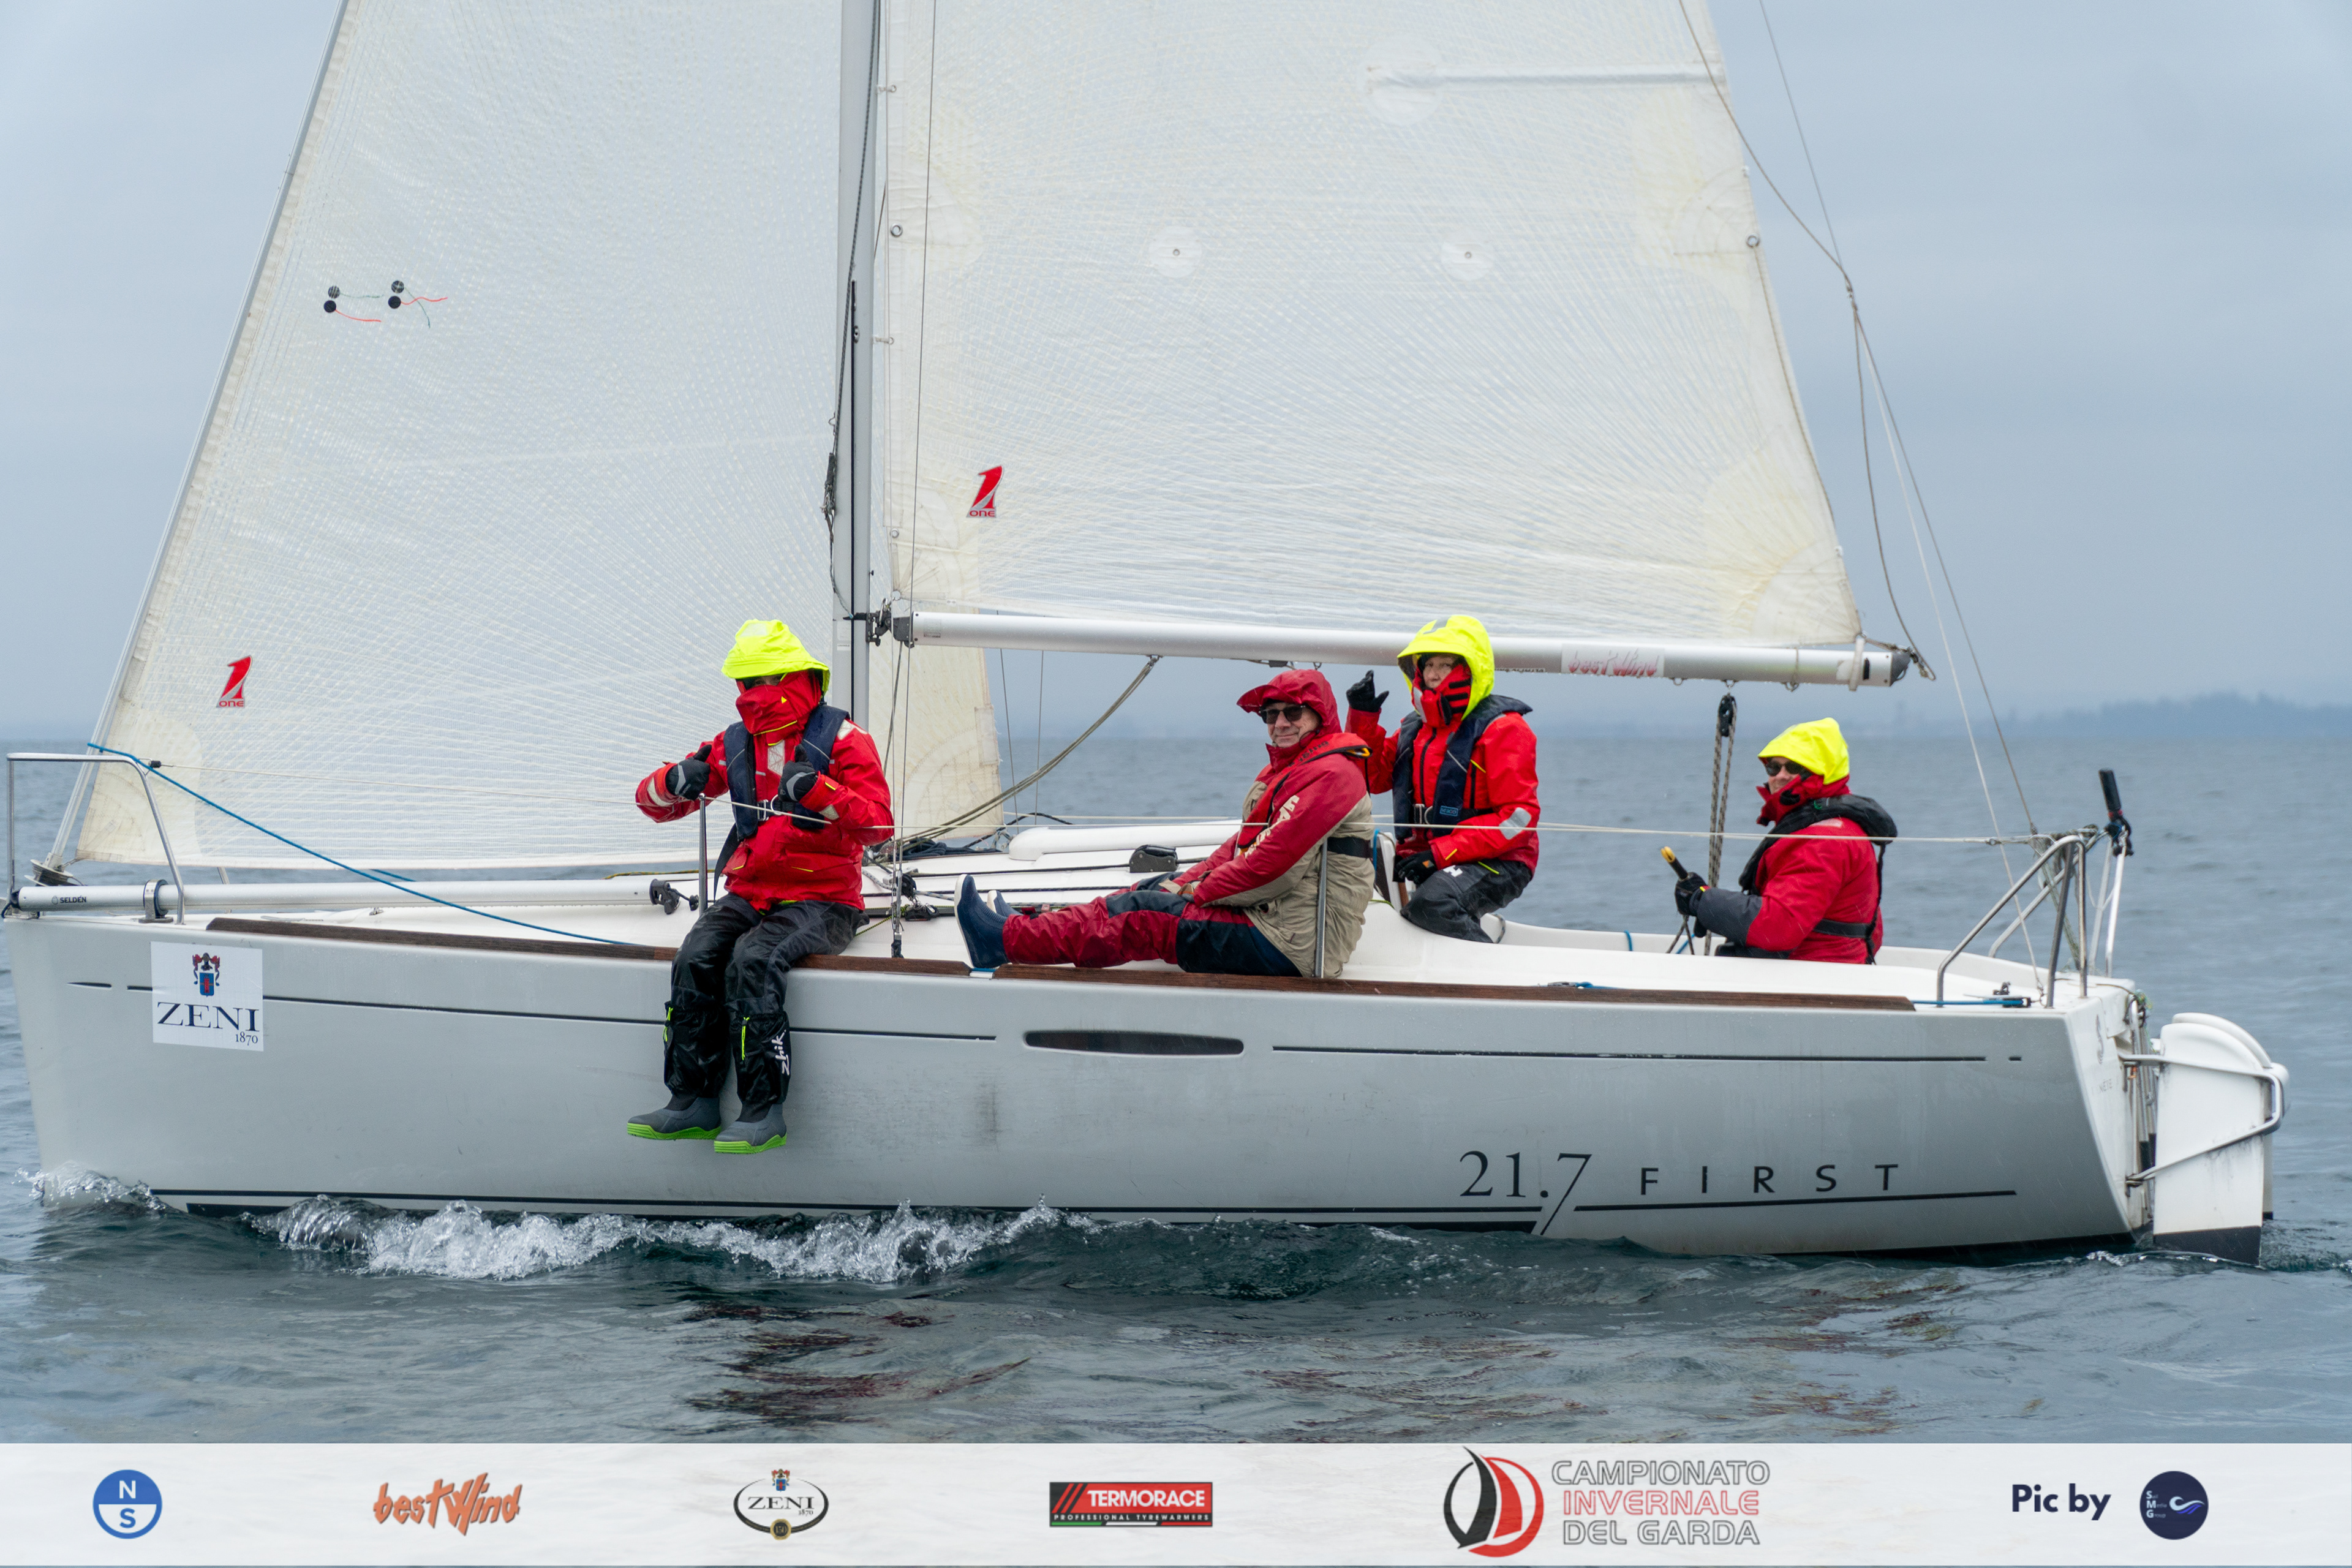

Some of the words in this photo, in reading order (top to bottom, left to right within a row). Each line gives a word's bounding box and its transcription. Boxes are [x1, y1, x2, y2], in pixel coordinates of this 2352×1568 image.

[157, 1002, 260, 1032] ZENI
[235, 1031, 258, 1046] 1870
[1460, 1150, 1592, 1235] 21.7
[1640, 1164, 1898, 1196] FIRST
